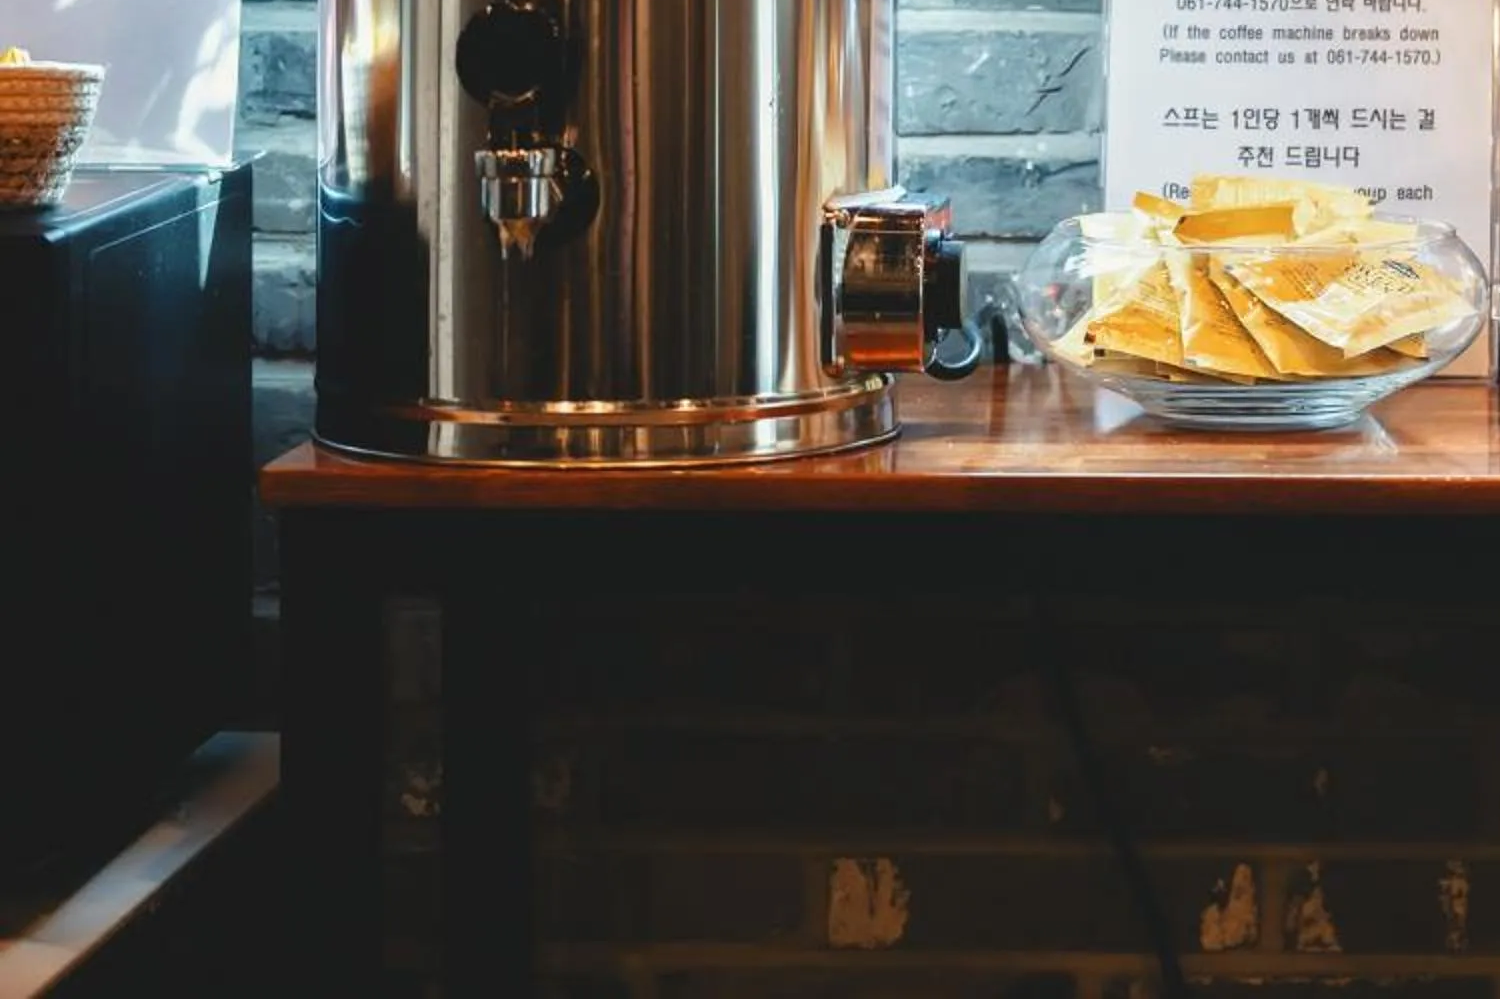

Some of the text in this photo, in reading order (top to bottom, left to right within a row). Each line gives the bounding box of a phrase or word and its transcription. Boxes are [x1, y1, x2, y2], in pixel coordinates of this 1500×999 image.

[1162, 23, 1440, 42] (If the coffee machine breaks down
[1159, 47, 1208, 65] Please
[1215, 48, 1270, 65] contact
[1277, 51, 1296, 65] us
[1303, 49, 1319, 65] at
[1161, 106, 1437, 132] 스프는 1인당 1개씩 드시는 걸
[1395, 184, 1434, 201] each
